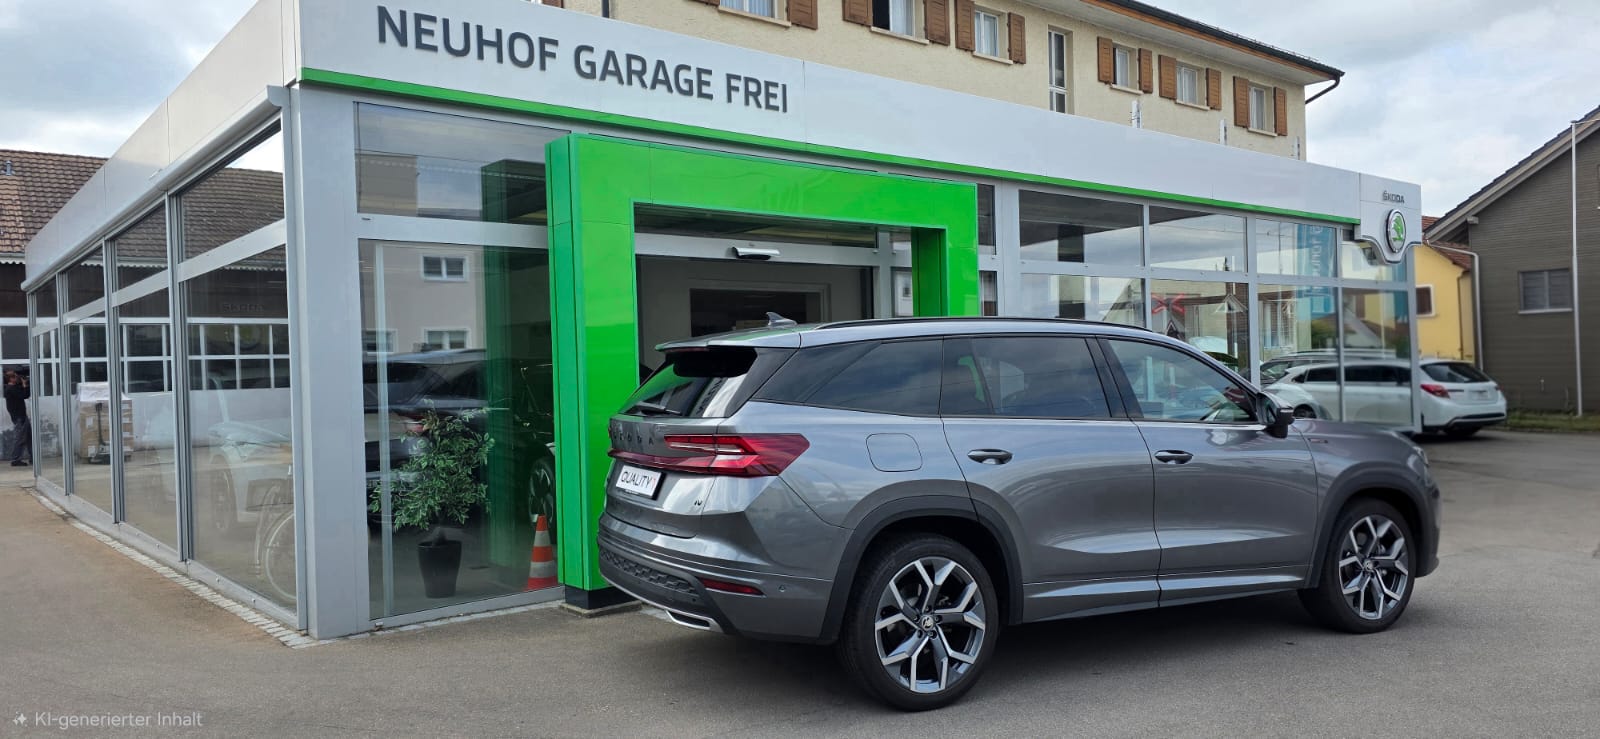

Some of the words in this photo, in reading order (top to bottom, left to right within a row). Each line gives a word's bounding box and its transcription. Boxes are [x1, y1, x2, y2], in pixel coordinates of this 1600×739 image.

[377, 5, 559, 71] NEUHOF
[574, 44, 714, 100] GARAGE
[725, 72, 788, 113] FREI
